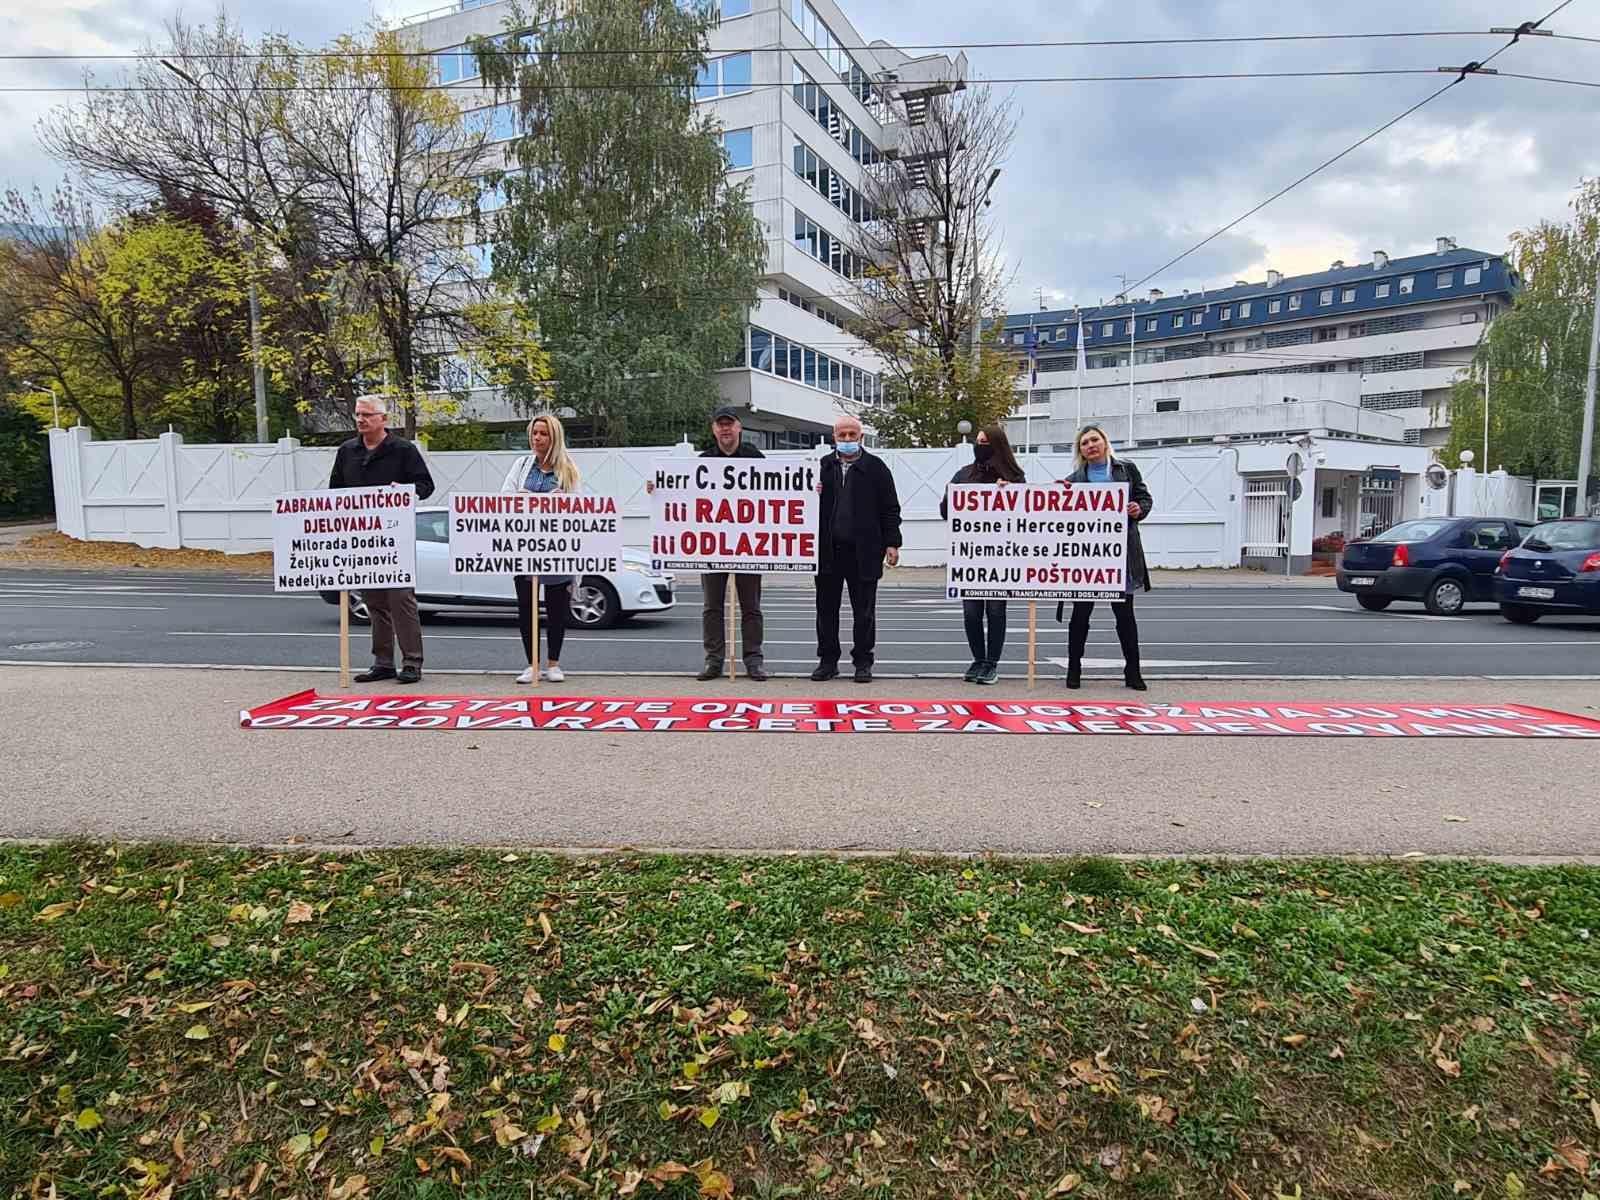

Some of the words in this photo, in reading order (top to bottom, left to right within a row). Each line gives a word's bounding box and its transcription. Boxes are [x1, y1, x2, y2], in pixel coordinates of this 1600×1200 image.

[656, 470, 690, 489] Herr
[696, 465, 716, 490] C.
[723, 465, 814, 491] Schmidt
[276, 497, 332, 514] ZABRANA
[336, 489, 410, 510] POLITIČKOG
[455, 496, 523, 513] UKINITE
[529, 497, 616, 513] PRIMANJA
[953, 491, 1018, 511] USTAV
[1025, 483, 1124, 512] (DRŽAVA)
[665, 503, 686, 522] ili
[696, 498, 804, 524] RADITE
[304, 516, 382, 533] DJELOVANJA
[456, 519, 500, 532] SVIMA
[505, 519, 535, 532] KOJI
[540, 519, 558, 532] NE
[563, 519, 616, 532] DOLAZE
[952, 519, 1001, 532] Bosne
[1008, 519, 1010, 532] i
[1017, 519, 1122, 536] Hercegovine
[292, 537, 347, 551] Milorada
[352, 536, 395, 548] Dodika
[493, 538, 513, 552] NA
[518, 538, 566, 552] POSAO
[572, 538, 580, 552] U
[653, 536, 675, 554] ili
[681, 532, 814, 556] ODLAZITE
[952, 543, 955, 556] i
[960, 541, 1029, 559] Njemačke
[1033, 546, 1049, 557] se
[1053, 543, 1121, 557] JEDNAKO
[290, 554, 328, 571] Željku
[333, 552, 398, 569] Cvijanović
[455, 553, 522, 572] DRŽAVNE
[528, 558, 616, 572] INSTITUCIJE
[280, 575, 334, 588] Nedeljka
[338, 570, 411, 585] Čubrilovića
[952, 568, 1020, 583] MORAJU
[1027, 564, 1121, 584] POŠTOVATI
[287, 699, 675, 713] ZAUSTAVITE
[689, 703, 814, 714] ONE
[838, 704, 973, 716] KOJI
[987, 704, 1400, 718] UGROŽAVAJU
[1401, 707, 1543, 719] MIR
[249, 715, 689, 729] ODGOVARAT
[708, 715, 893, 731] ĆETE
[912, 720, 1008, 731] ZA
